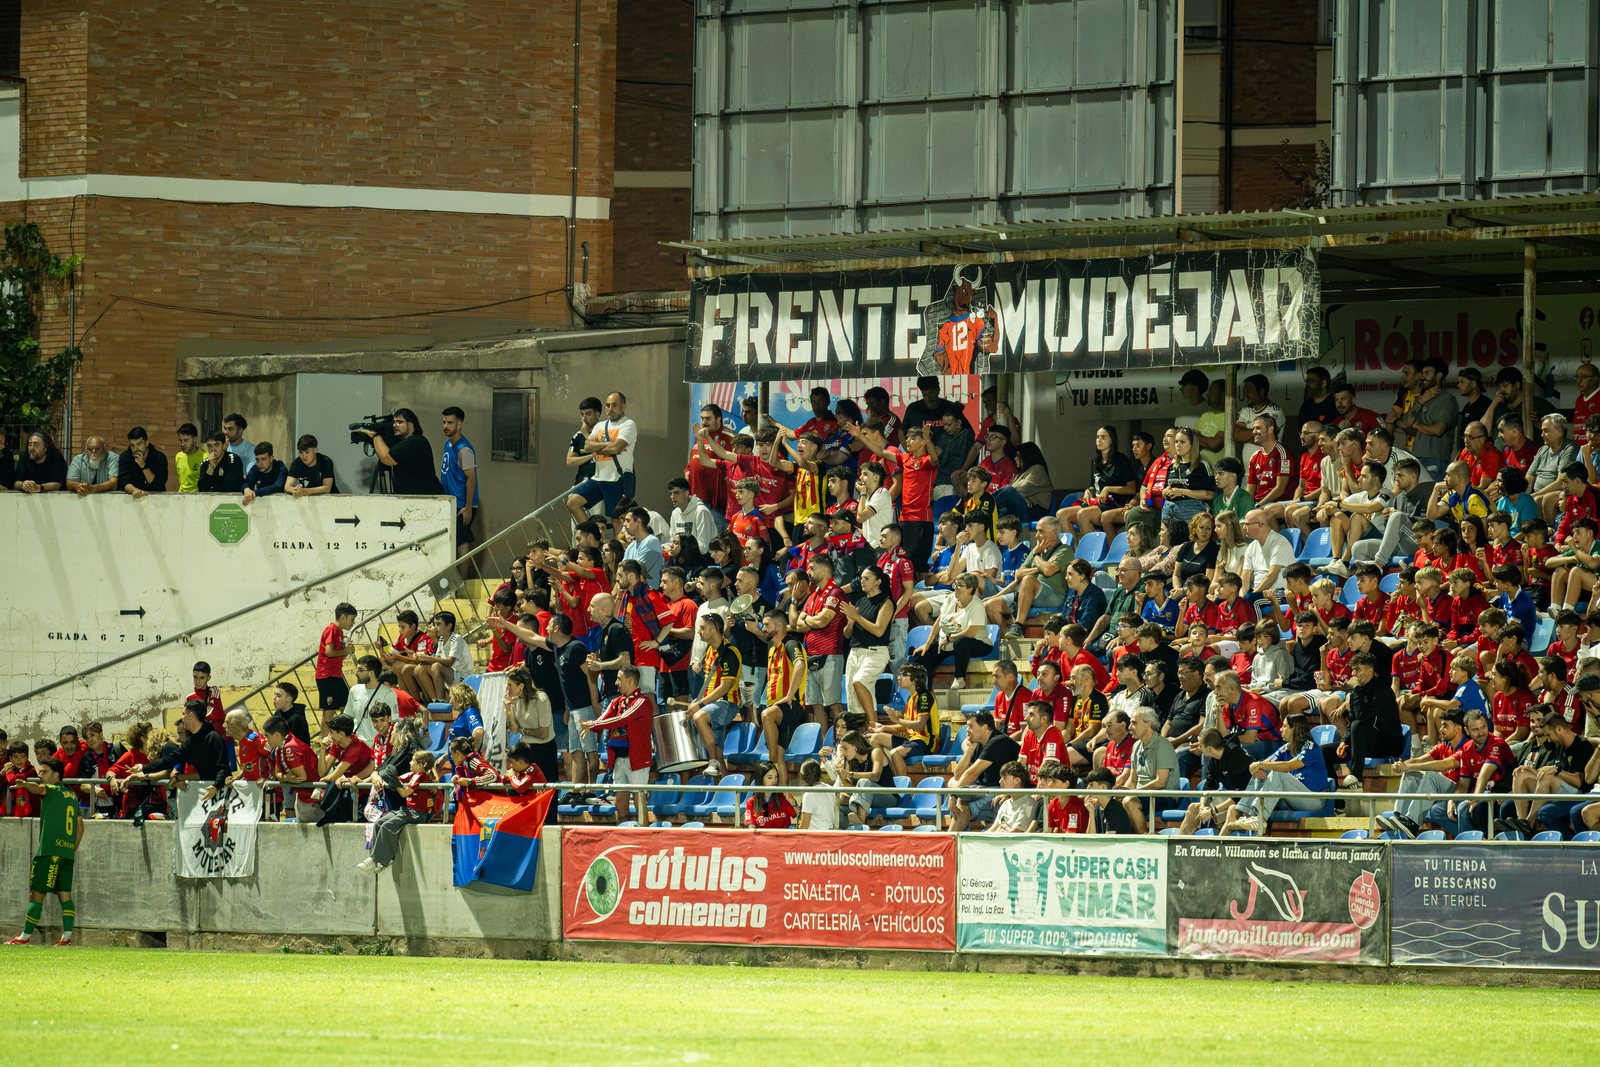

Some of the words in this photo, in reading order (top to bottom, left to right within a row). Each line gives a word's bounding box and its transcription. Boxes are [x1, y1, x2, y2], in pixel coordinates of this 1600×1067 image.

[699, 284, 932, 366] FRENTE
[990, 261, 1304, 355] MUDÉJAR
[952, 321, 968, 350] 12
[1354, 312, 1519, 371] Rótulos
[1072, 388, 1089, 406] TU
[1094, 387, 1159, 406] EMPRESA
[273, 541, 314, 550] GRADA
[327, 542, 340, 550] 12
[48, 632, 88, 641] GRADA
[100, 634, 107, 642] 6
[119, 634, 126, 642] 7
[138, 634, 145, 642] 8
[155, 634, 162, 642] 9
[204, 637, 214, 645] 11
[65, 805, 75, 836] 6
[784, 849, 944, 868] www.rotuloscolmenero.com
[1175, 845, 1188, 857] En
[1190, 845, 1222, 858] Teruel,
[1224, 845, 1266, 858] Villamón
[1269, 850, 1280, 858] se
[1282, 847, 1309, 859] llama
[1312, 848, 1322, 860] al
[1325, 849, 1348, 860] buen
[1348, 849, 1381, 863] jamón
[628, 846, 769, 893] rótulos
[1055, 849, 1110, 879] SÚPER
[1113, 857, 1159, 880] CASH
[1424, 859, 1438, 871] TU
[1443, 859, 1487, 872] TIENDA
[1581, 859, 1598, 876] LA
[1414, 876, 1428, 888] DE
[1434, 876, 1497, 890] DESCANSO
[783, 881, 861, 903] SEÑALÉTICA
[885, 883, 945, 905] RÓTULOS
[961, 892, 984, 902] parcela
[1055, 881, 1157, 920] VIMAR
[1354, 893, 1375, 908] tienda
[1423, 894, 1438, 906] EN
[1443, 894, 1487, 907] TERUEL
[629, 896, 768, 928] colmenero
[961, 905, 972, 914] Pol.
[973, 905, 984, 914] Ind.
[985, 905, 992, 914] La
[994, 906, 1005, 914] Paz
[1351, 902, 1376, 919] ONLINE
[783, 911, 861, 933] CARTELERÍA
[872, 914, 945, 934] VEHÍCULOS
[984, 929, 996, 944] TU
[1000, 926, 1033, 945] SÚPER
[1038, 930, 1069, 946] 100%
[1074, 932, 1138, 948] TUROLENSE
[1186, 923, 1357, 949] jamonvillamon.com
